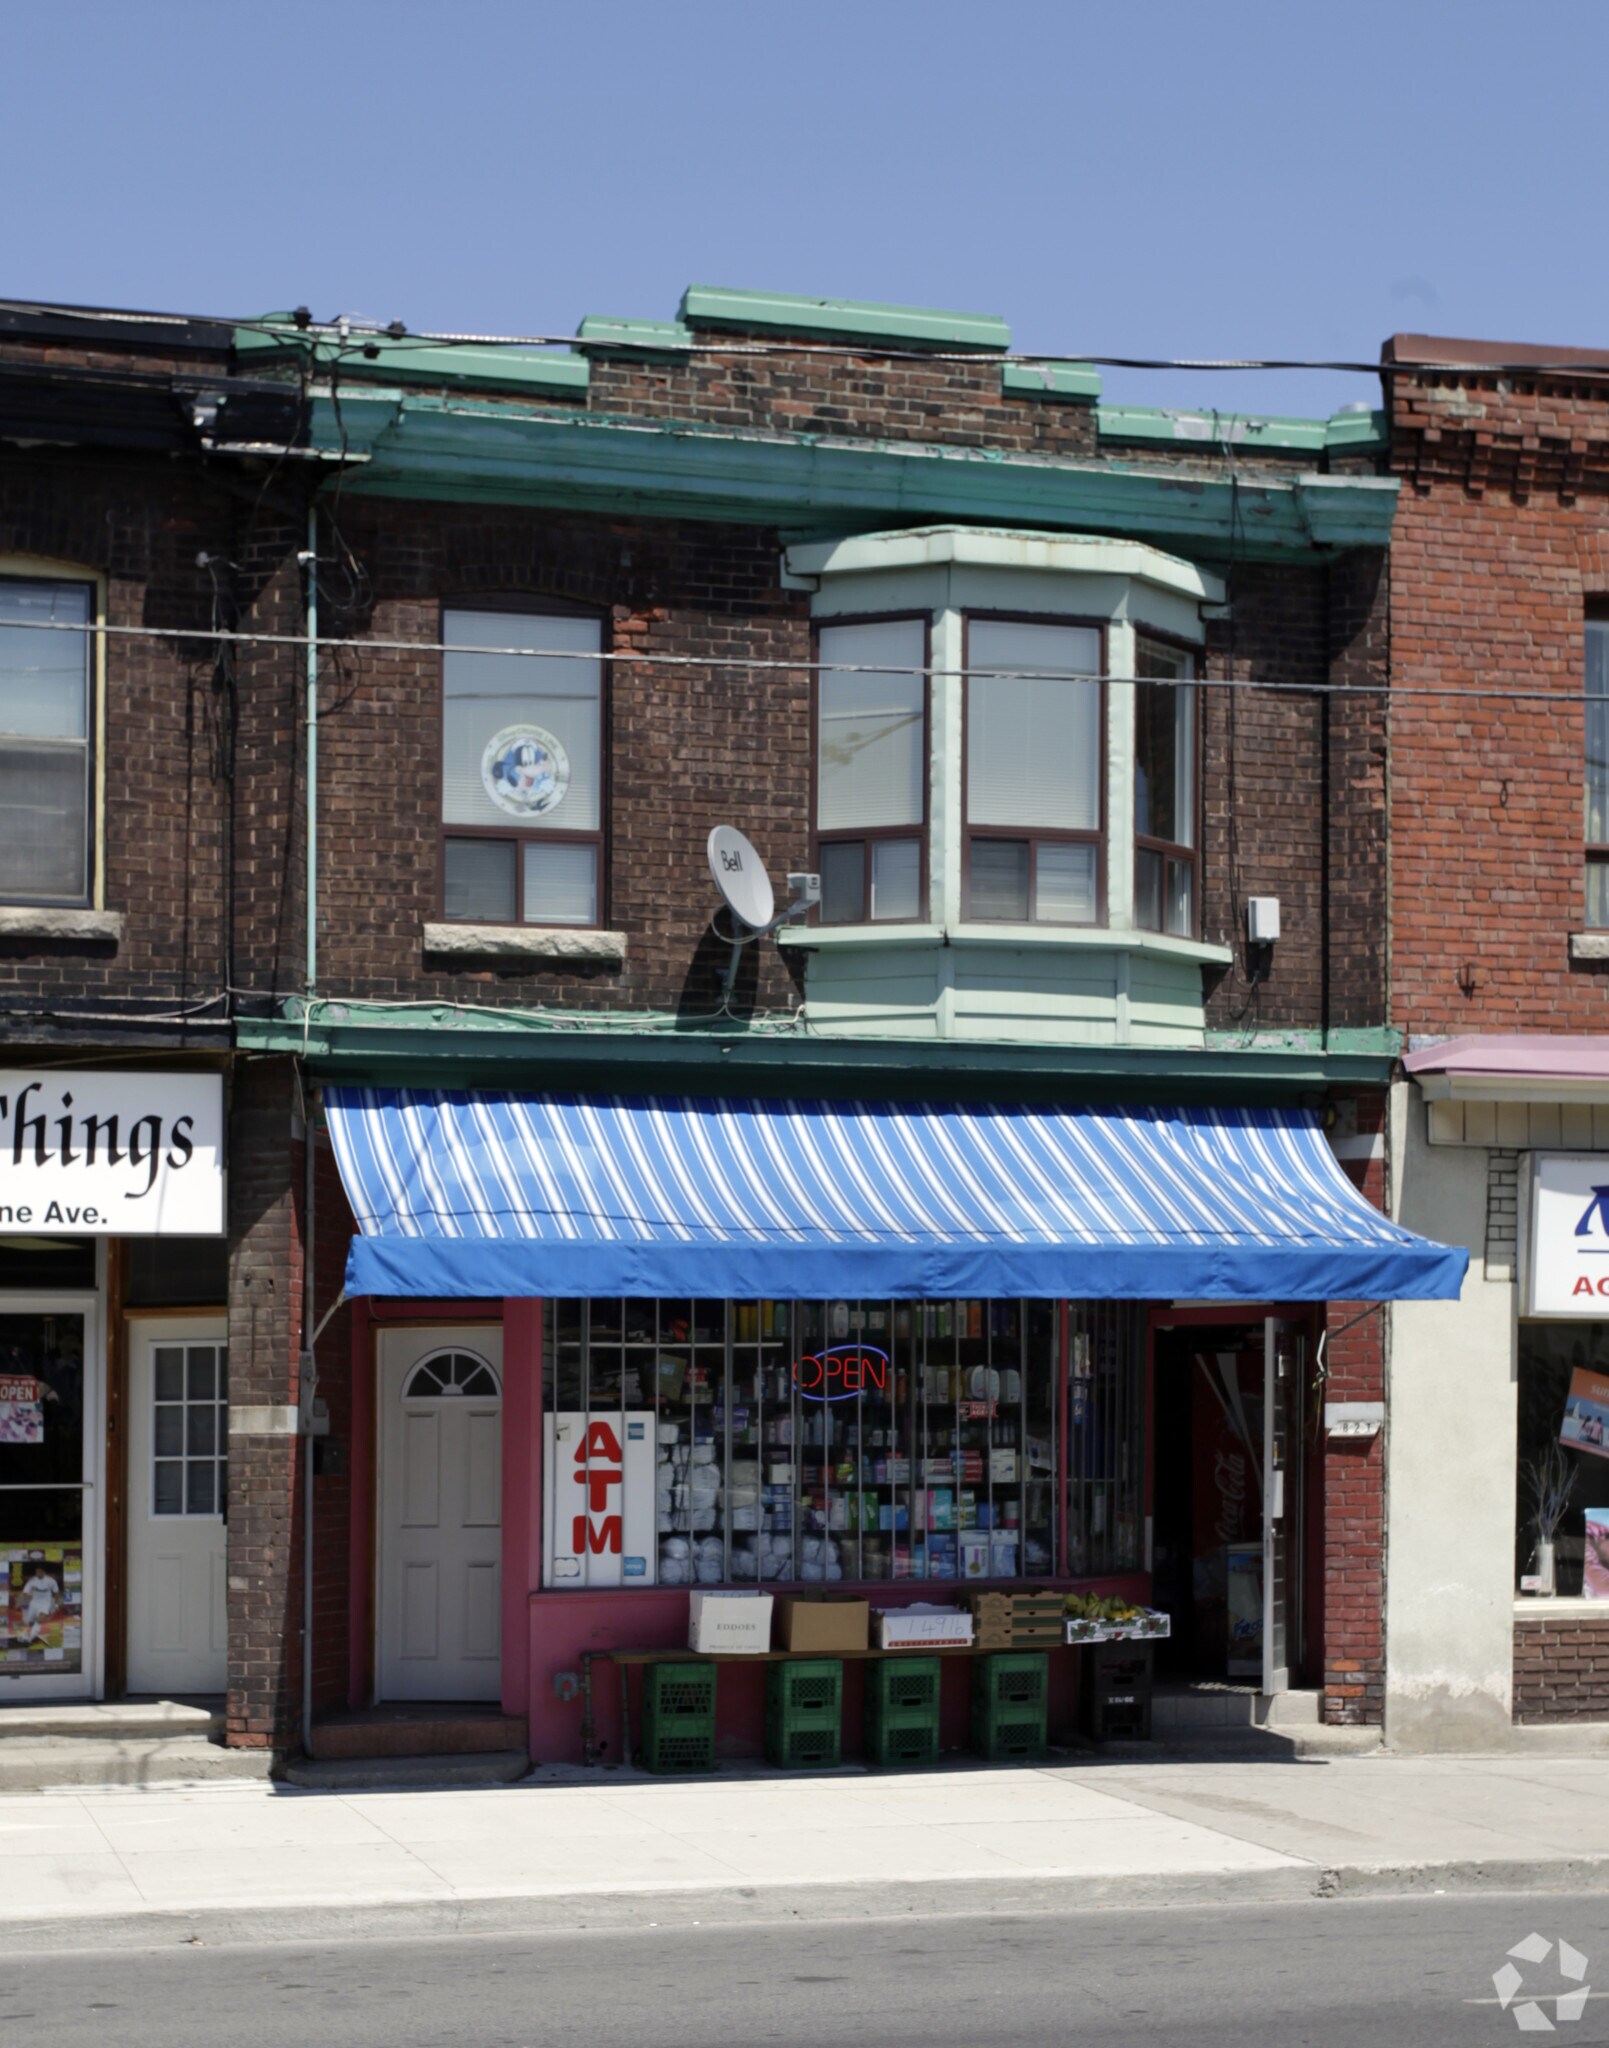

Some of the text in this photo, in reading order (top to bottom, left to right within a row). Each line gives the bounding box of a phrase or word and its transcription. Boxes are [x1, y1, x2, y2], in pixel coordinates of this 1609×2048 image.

[720, 850, 743, 872] Bell
[0, 1081, 195, 1200] hings
[44, 1200, 109, 1224] Ave.
[793, 1355, 886, 1390] OPEN
[0, 1385, 34, 1401] OPEN
[572, 1421, 623, 1555] ATM
[716, 1623, 757, 1632] EDDOES
